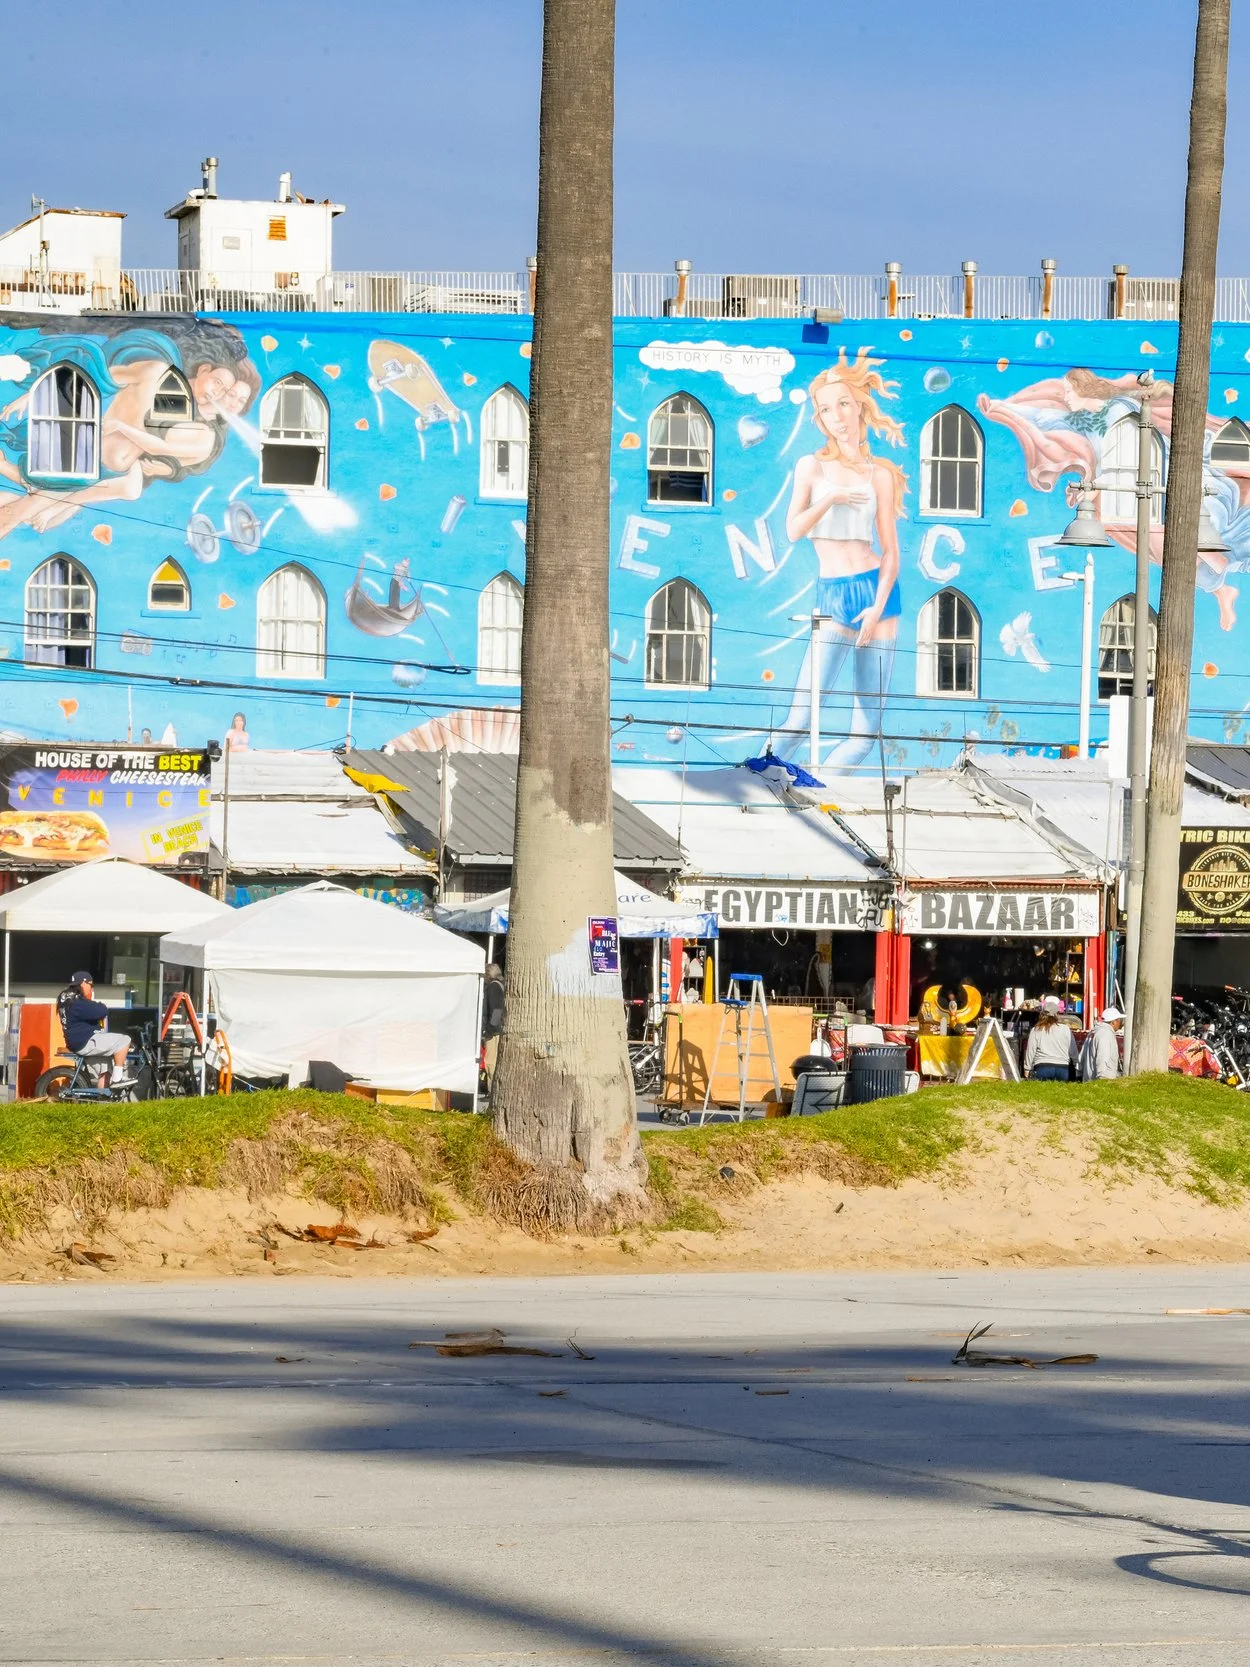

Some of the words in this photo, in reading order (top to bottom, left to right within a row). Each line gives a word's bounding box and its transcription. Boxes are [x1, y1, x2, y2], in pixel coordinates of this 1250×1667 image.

[653, 350, 710, 362] HISTORY
[720, 353, 733, 365] IS
[742, 354, 781, 366] MYTH
[35, 751, 92, 768] HOUSE
[95, 753, 119, 769] OF
[123, 753, 155, 769] THE
[158, 754, 202, 771] BEST
[56, 769, 109, 783] PHILLY
[109, 769, 210, 787] CHEESESTEAK
[166, 820, 204, 839] VENICE
[163, 833, 198, 853] BEACH
[703, 889, 857, 925] EGYPTIAN
[921, 893, 1075, 931] BAZAAR
